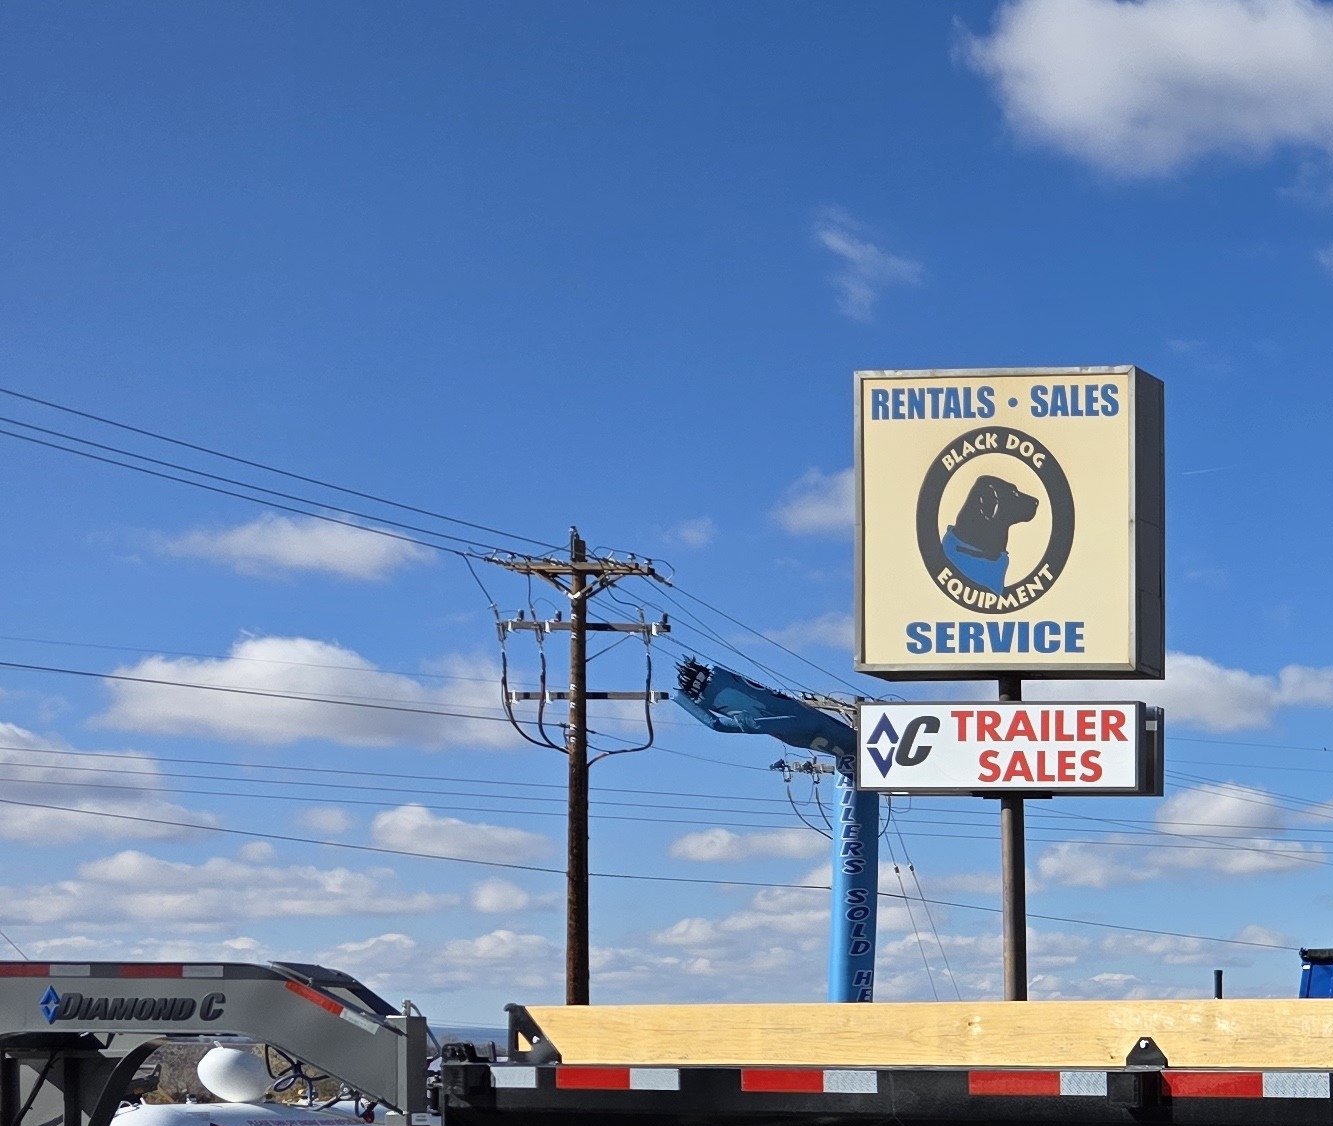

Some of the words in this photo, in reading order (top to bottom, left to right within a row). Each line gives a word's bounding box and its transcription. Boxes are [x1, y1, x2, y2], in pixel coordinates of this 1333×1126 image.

[871, 385, 995, 420] RENTALS
[1030, 383, 1119, 417] SALES
[942, 432, 998, 472] BLACK
[1006, 433, 1046, 469] DOG
[937, 564, 1054, 611] EQUIPMENT
[906, 621, 1085, 654] SERVICE
[950, 710, 1128, 742] TRAILER
[978, 750, 1102, 783] SALES
[844, 887, 872, 957] SOLD
[56, 992, 197, 1021] DIAMOND
[200, 991, 226, 1021] C
